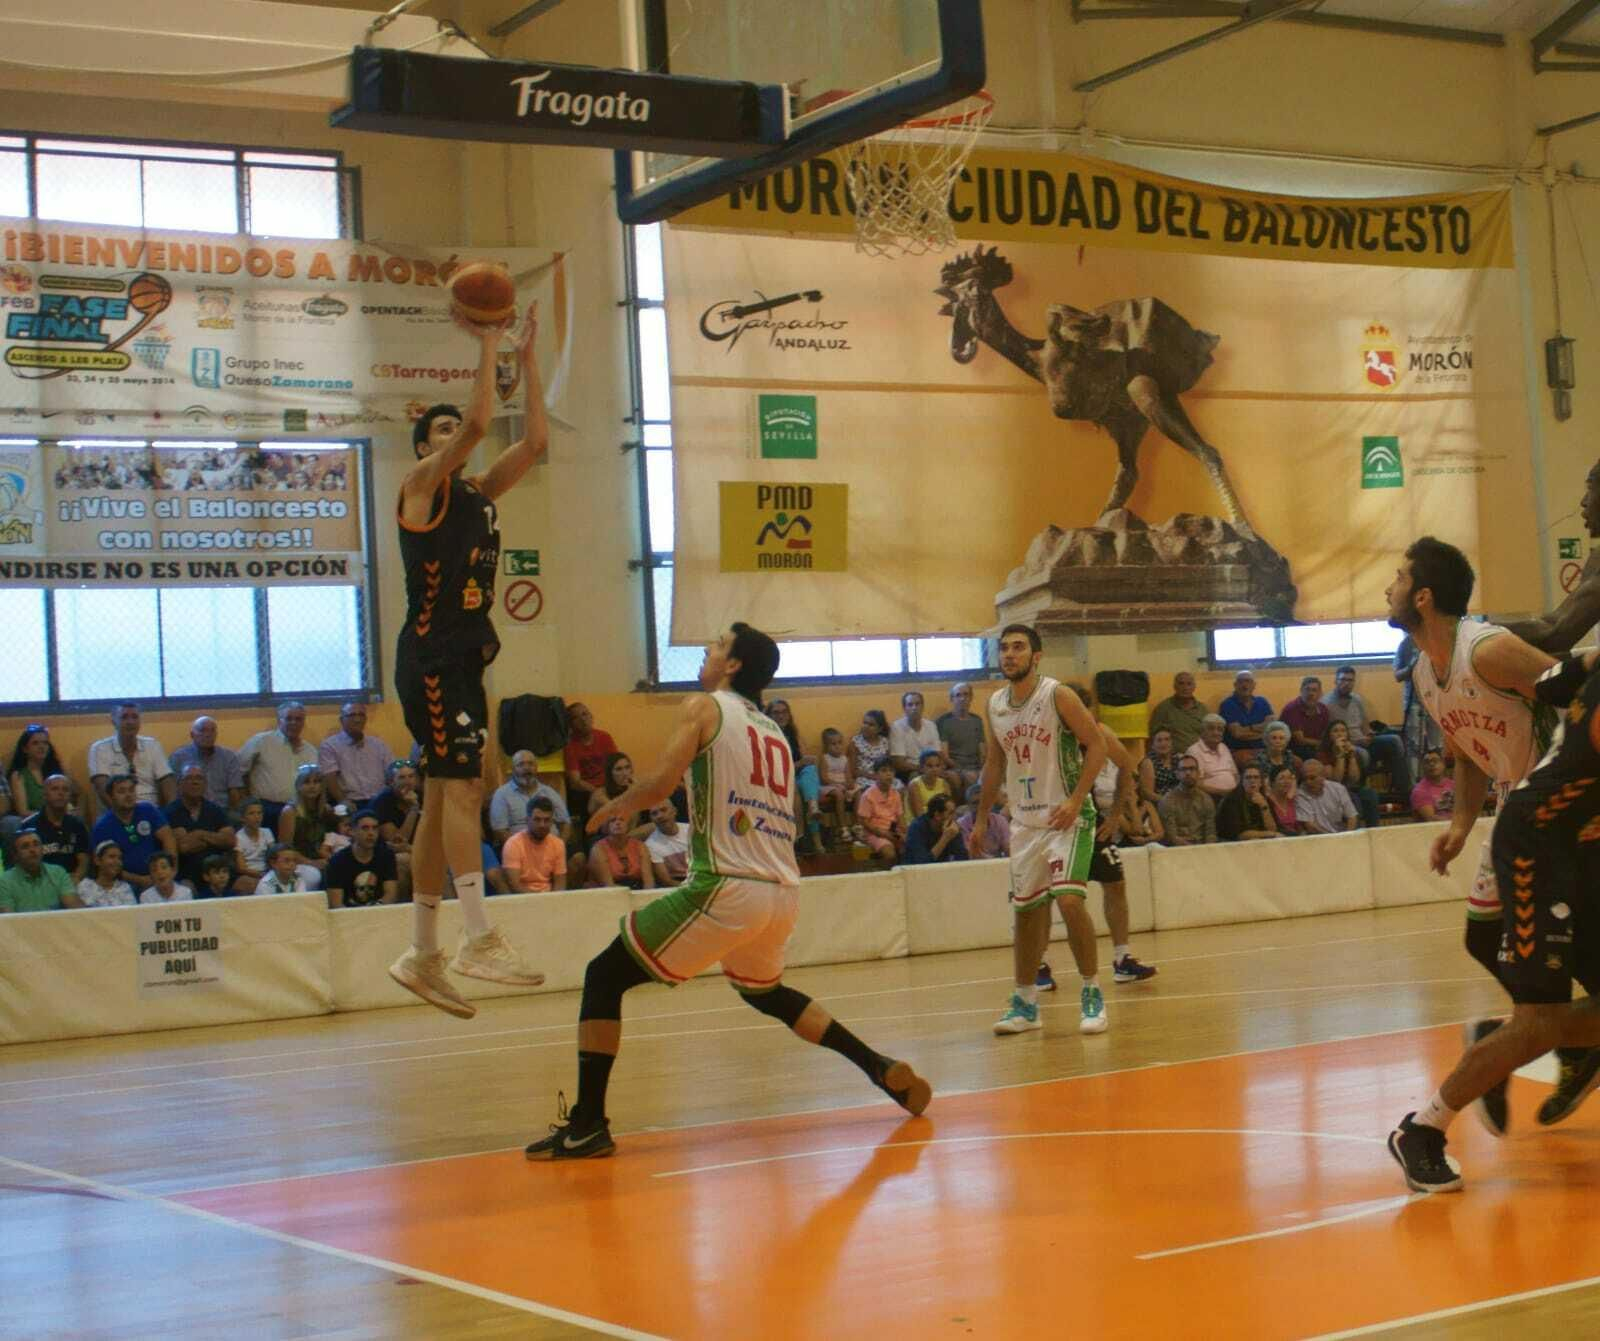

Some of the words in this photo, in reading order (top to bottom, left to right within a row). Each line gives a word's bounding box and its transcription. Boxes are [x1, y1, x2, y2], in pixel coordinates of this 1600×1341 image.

[510, 70, 649, 126] Fragata
[947, 164, 1120, 230] CIUDAD
[1134, 180, 1210, 239] DEL
[1219, 198, 1471, 256] BALONCESTO
[307, 252, 337, 280] A
[347, 253, 460, 288] MOR
[40, 294, 128, 320] FASE
[360, 305, 422, 315] OPENTACH
[6, 313, 110, 343] FINAL
[775, 338, 852, 352] ANDALUZ
[225, 356, 271, 371] Grupo
[274, 358, 305, 371] Inec
[1408, 345, 1473, 371] MORÓN
[764, 431, 813, 440] SEVILLA
[757, 484, 813, 510] PMD
[154, 499, 181, 518] el
[188, 499, 348, 519] Baloncesto
[99, 529, 152, 549] con
[160, 528, 314, 549] nosotros!!
[104, 562, 143, 579] NO
[151, 562, 181, 579] ES
[188, 561, 240, 578] UNA
[246, 555, 348, 578] OPCIÓN
[747, 725, 790, 798] 10
[1014, 744, 1031, 765] 14
[155, 919, 182, 934] PON
[184, 917, 202, 932] TU
[140, 936, 219, 956] PUBLICIDAD
